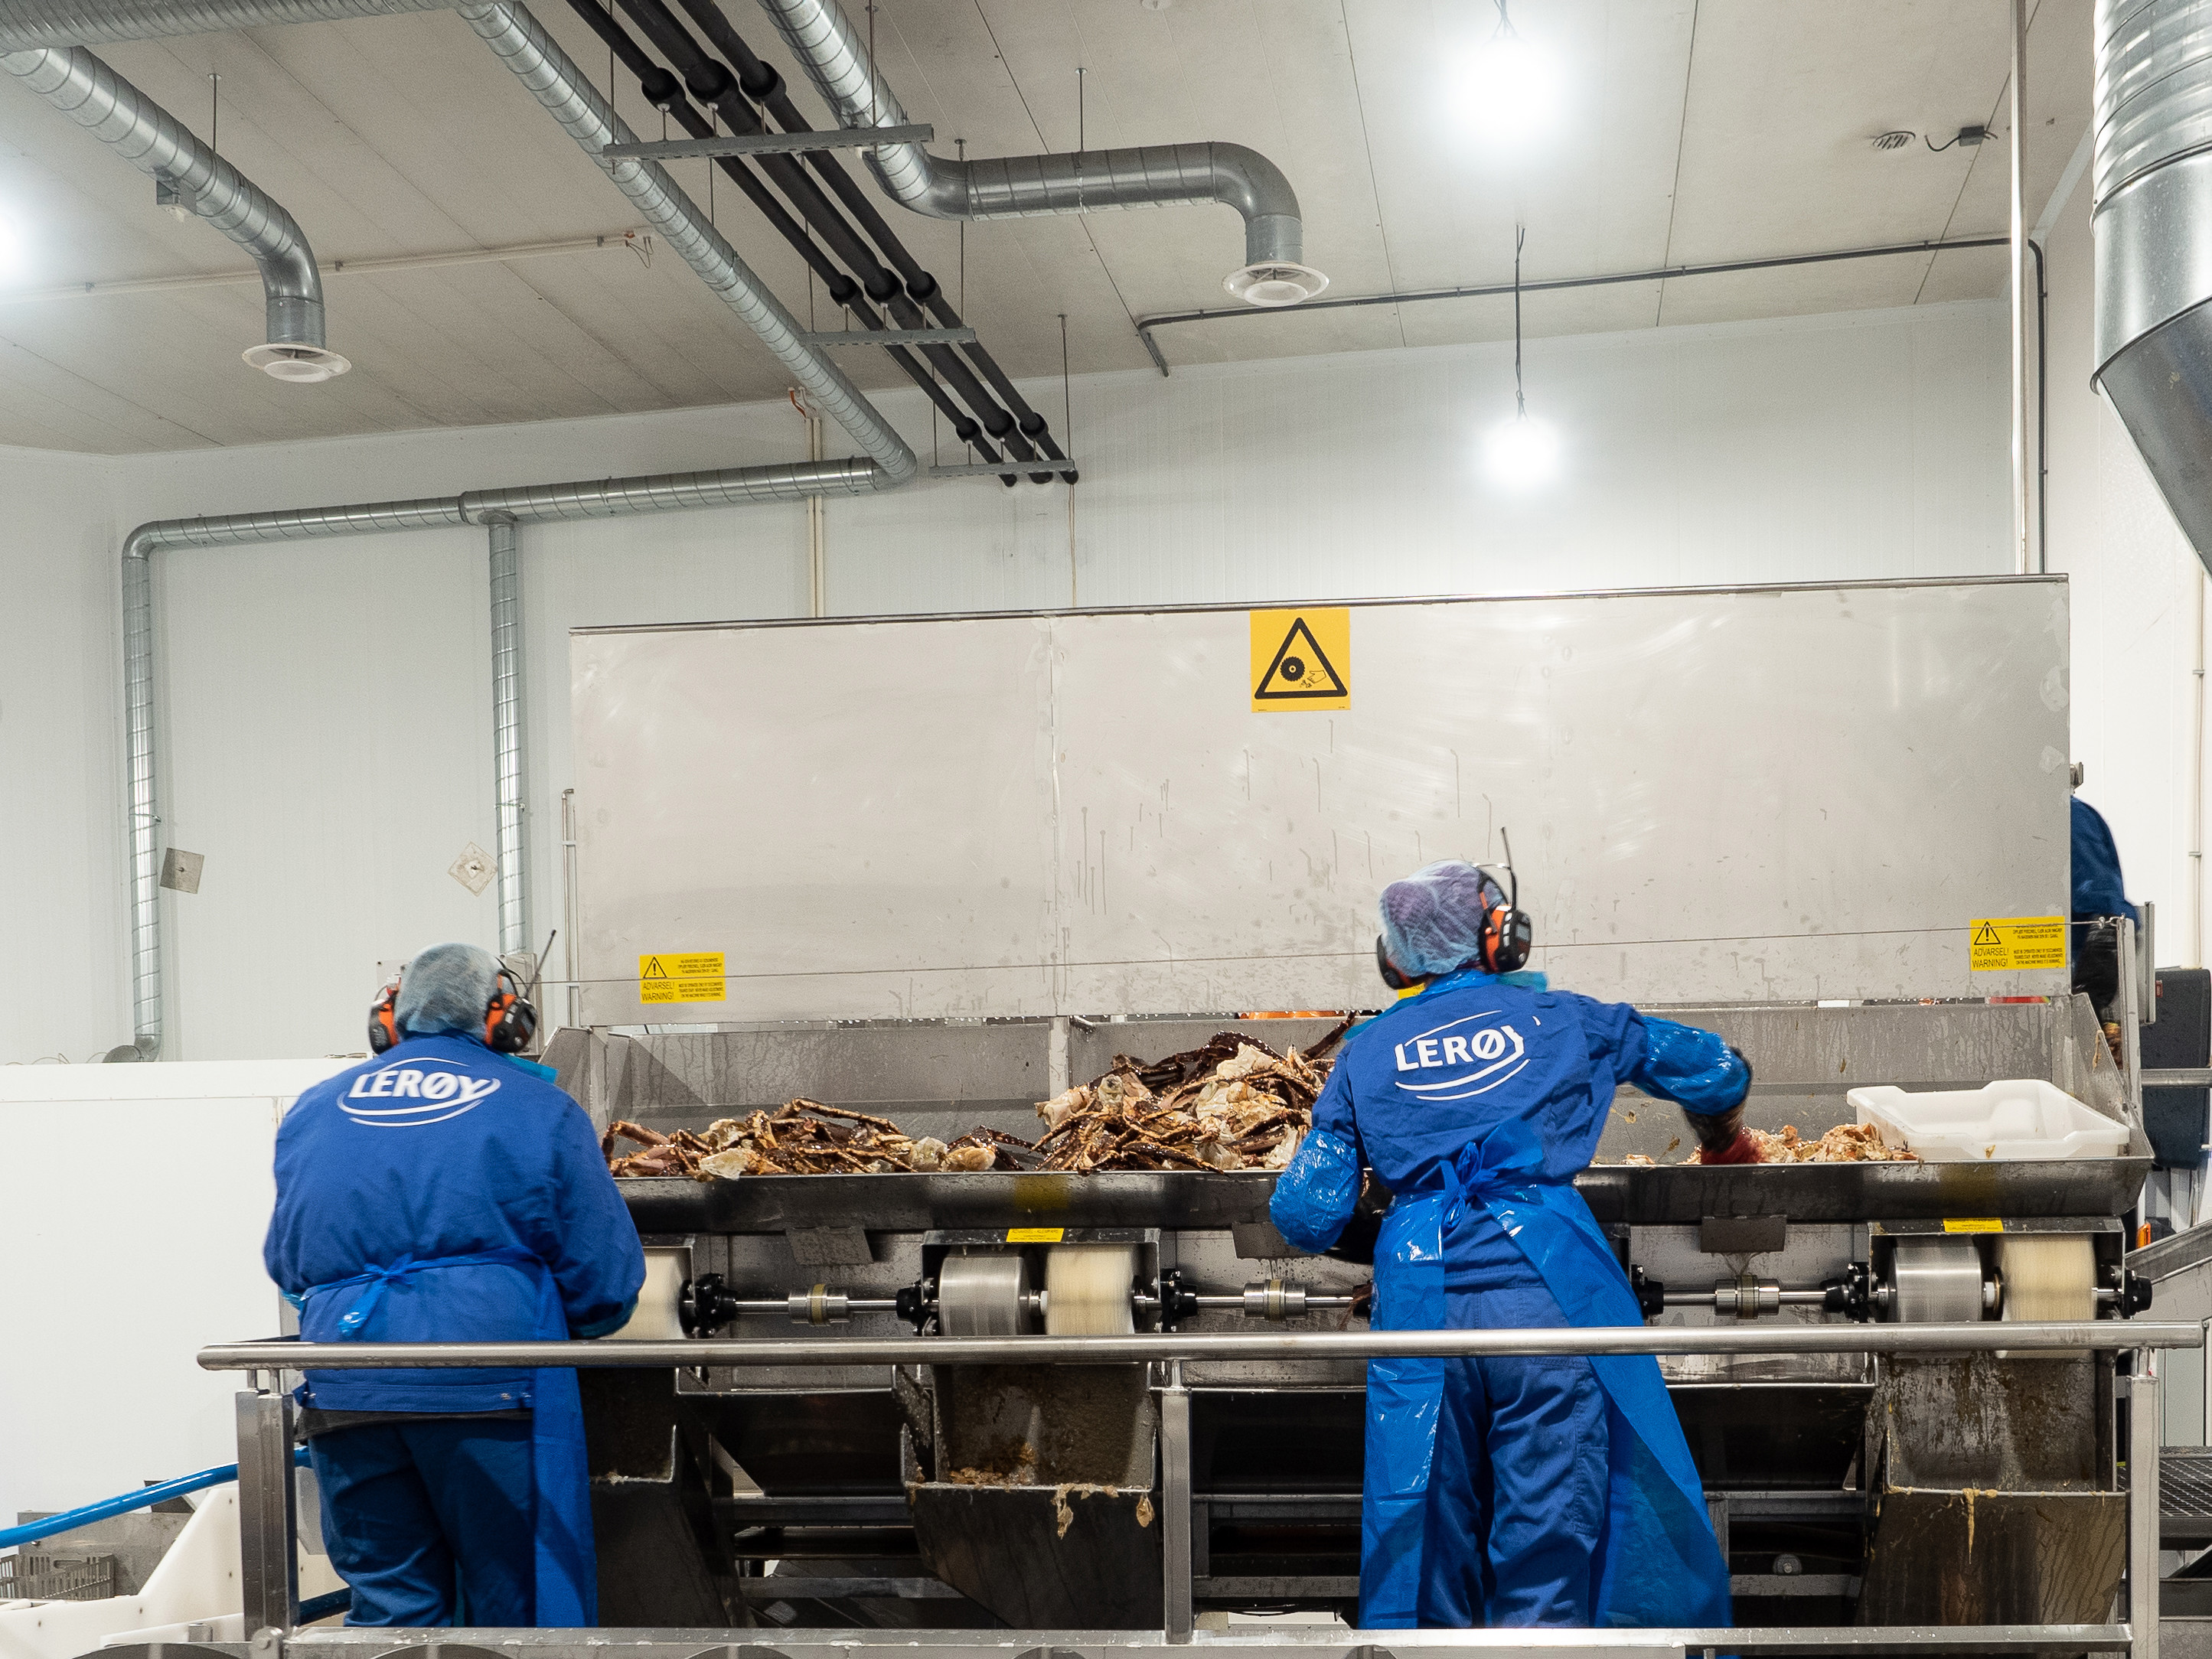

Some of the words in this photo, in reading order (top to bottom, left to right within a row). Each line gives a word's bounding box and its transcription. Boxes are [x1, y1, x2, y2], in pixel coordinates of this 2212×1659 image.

[1973, 947, 2009, 957] ADVARSEL!
[1972, 958, 2008, 968] WARNING!
[641, 991, 674, 1001] WARNING!
[347, 1070, 491, 1100] LERØY
